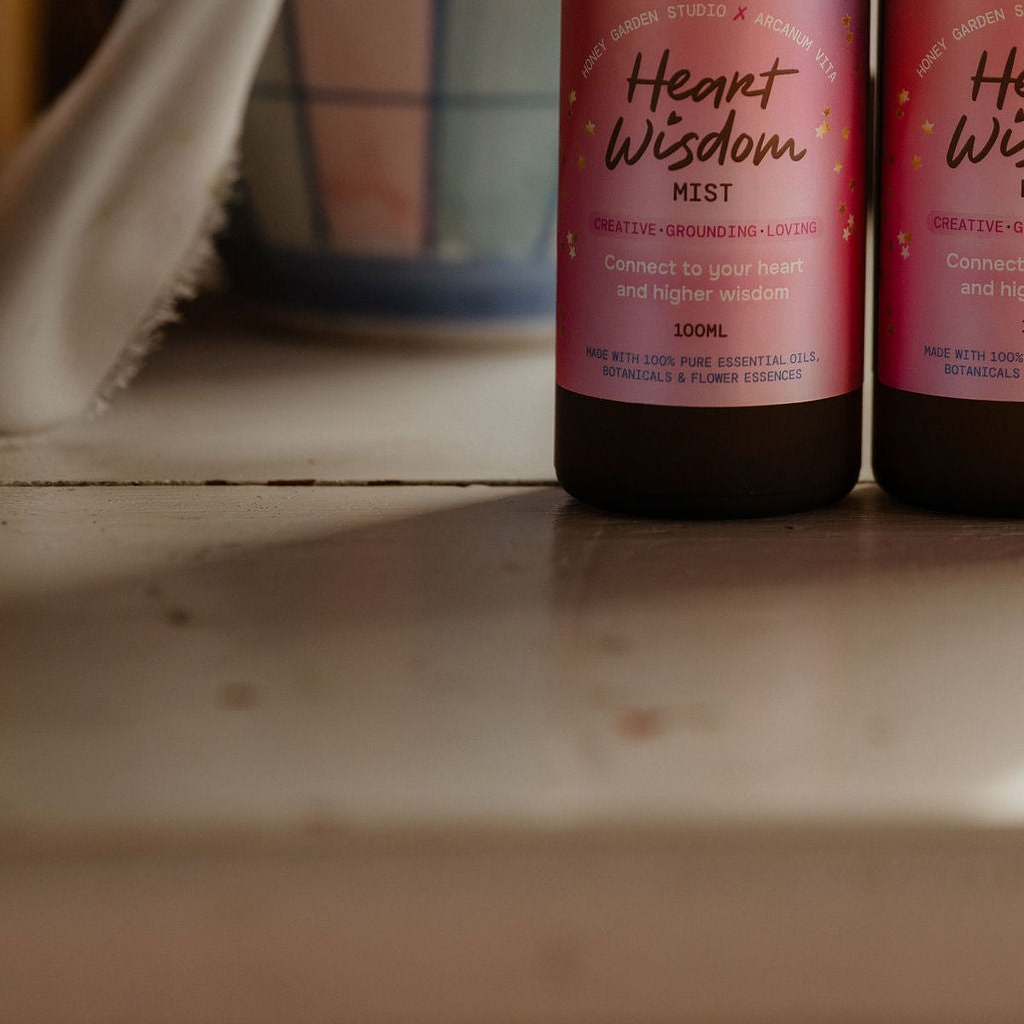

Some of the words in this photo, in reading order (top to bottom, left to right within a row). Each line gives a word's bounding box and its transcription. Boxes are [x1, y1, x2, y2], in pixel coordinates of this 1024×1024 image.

[580, 39, 608, 80] HONEY
[610, 9, 659, 42] GARDEN
[667, 3, 727, 19] STUDIO
[754, 12, 814, 51] ARCANUM
[815, 47, 838, 84] VITA
[916, 37, 948, 79] HONEY
[952, 8, 1006, 41] GARDEN
[626, 48, 799, 112] Heart
[605, 109, 807, 171] Wisdom
[673, 182, 733, 202] MIST
[604, 255, 677, 276] Connect
[683, 262, 703, 277] to
[709, 262, 752, 281] your
[757, 257, 804, 275] heart
[946, 252, 1024, 272] Connect
[616, 283, 648, 300] and
[653, 284, 713, 306] higher
[719, 285, 790, 302] wisdom
[960, 280, 994, 296] and
[673, 323, 728, 339] 100ML
[586, 346, 608, 360] MADE
[611, 350, 640, 364] WITH
[643, 353, 676, 367] 100%
[680, 356, 712, 369] PURE
[717, 354, 787, 368] ESSENTIAL
[789, 350, 820, 364] OILS,
[924, 344, 951, 359] MADE
[954, 349, 986, 362] WITH
[990, 351, 1024, 363] 100%
[602, 365, 673, 384] BOTANICALS
[677, 371, 686, 384] &
[691, 371, 739, 384] FLOWER
[744, 368, 802, 383] ESSENCES
[944, 363, 1020, 379] BOTANICALS
